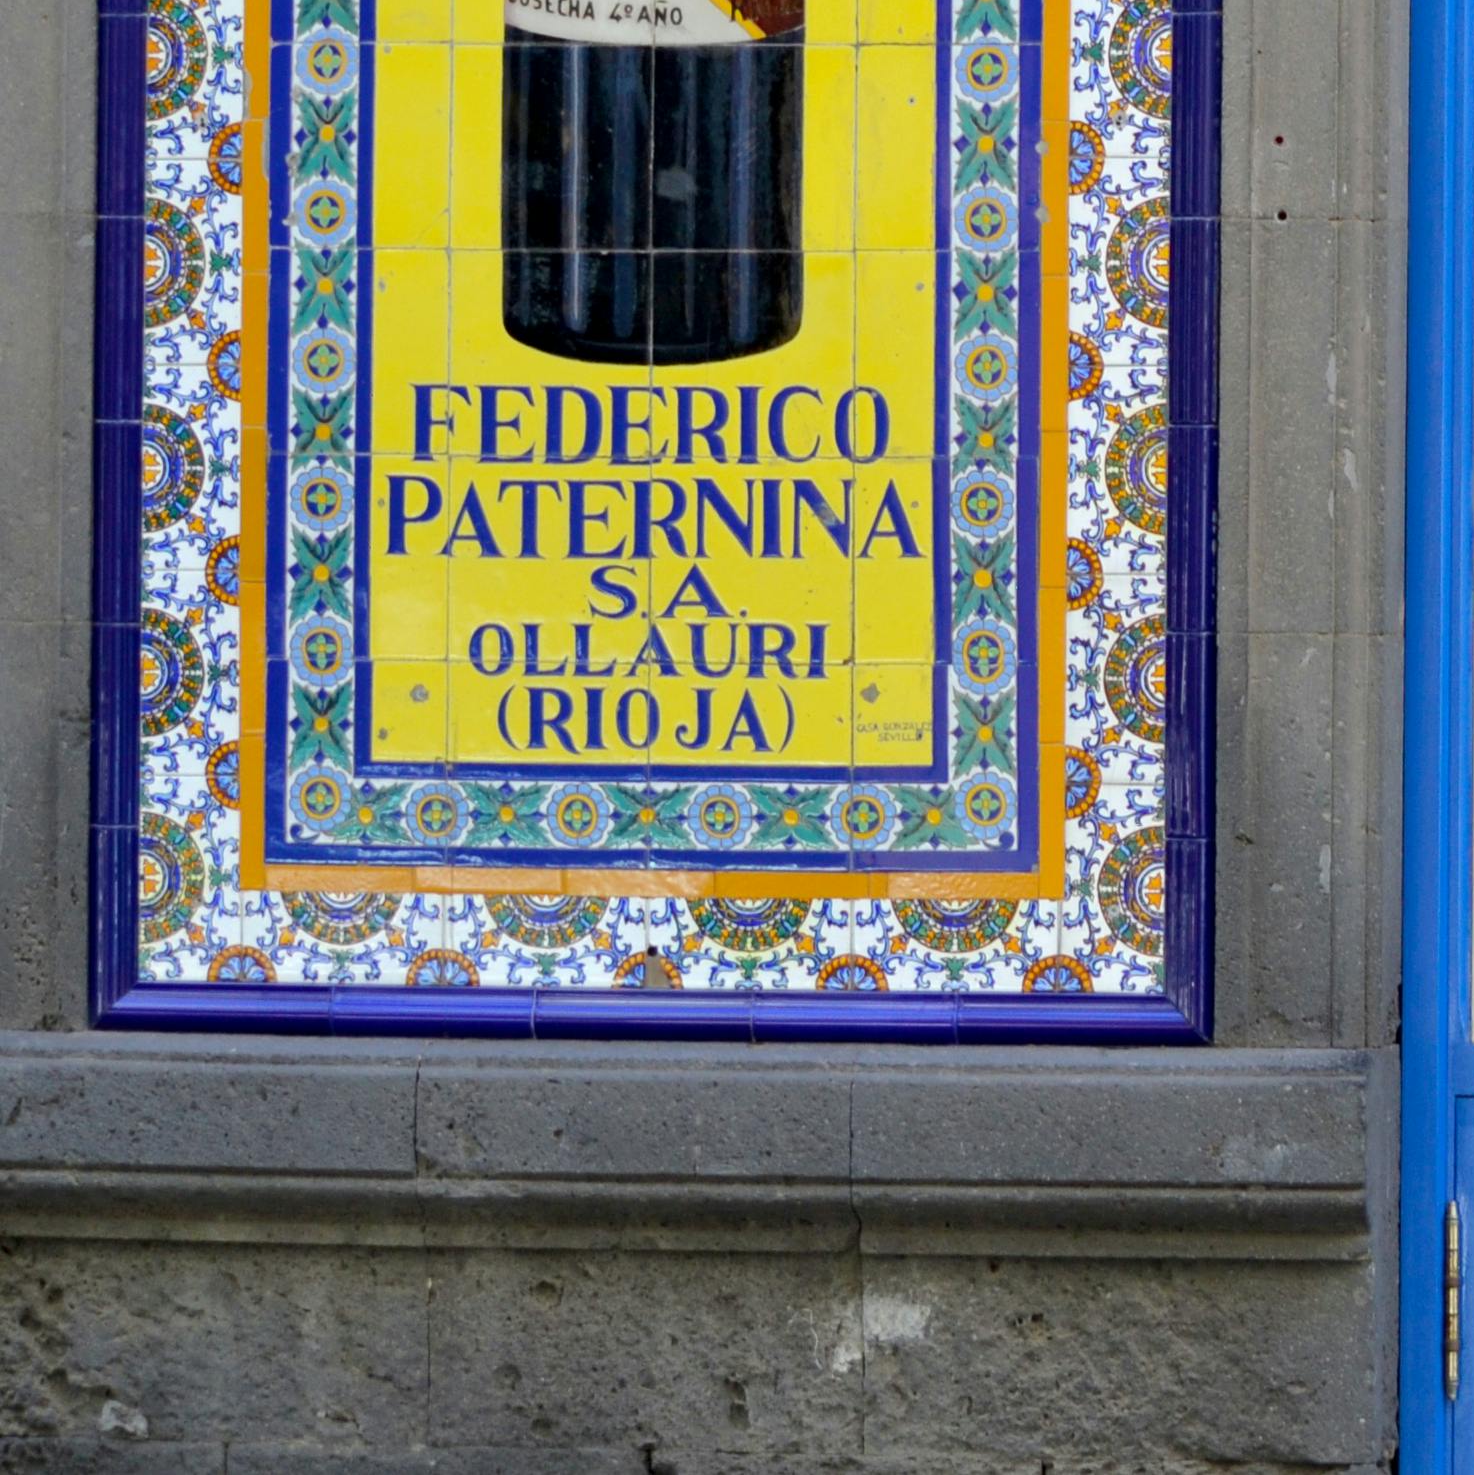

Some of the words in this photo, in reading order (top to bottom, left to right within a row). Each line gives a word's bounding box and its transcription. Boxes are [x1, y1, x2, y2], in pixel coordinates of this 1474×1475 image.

[637, 0, 683, 26] AÑO
[411, 383, 891, 466] FEDERICO
[385, 474, 927, 559] PATERNINA
[588, 563, 748, 619] S.A.
[468, 621, 830, 680] OLLAURI
[497, 685, 795, 754] (RIOJA)
